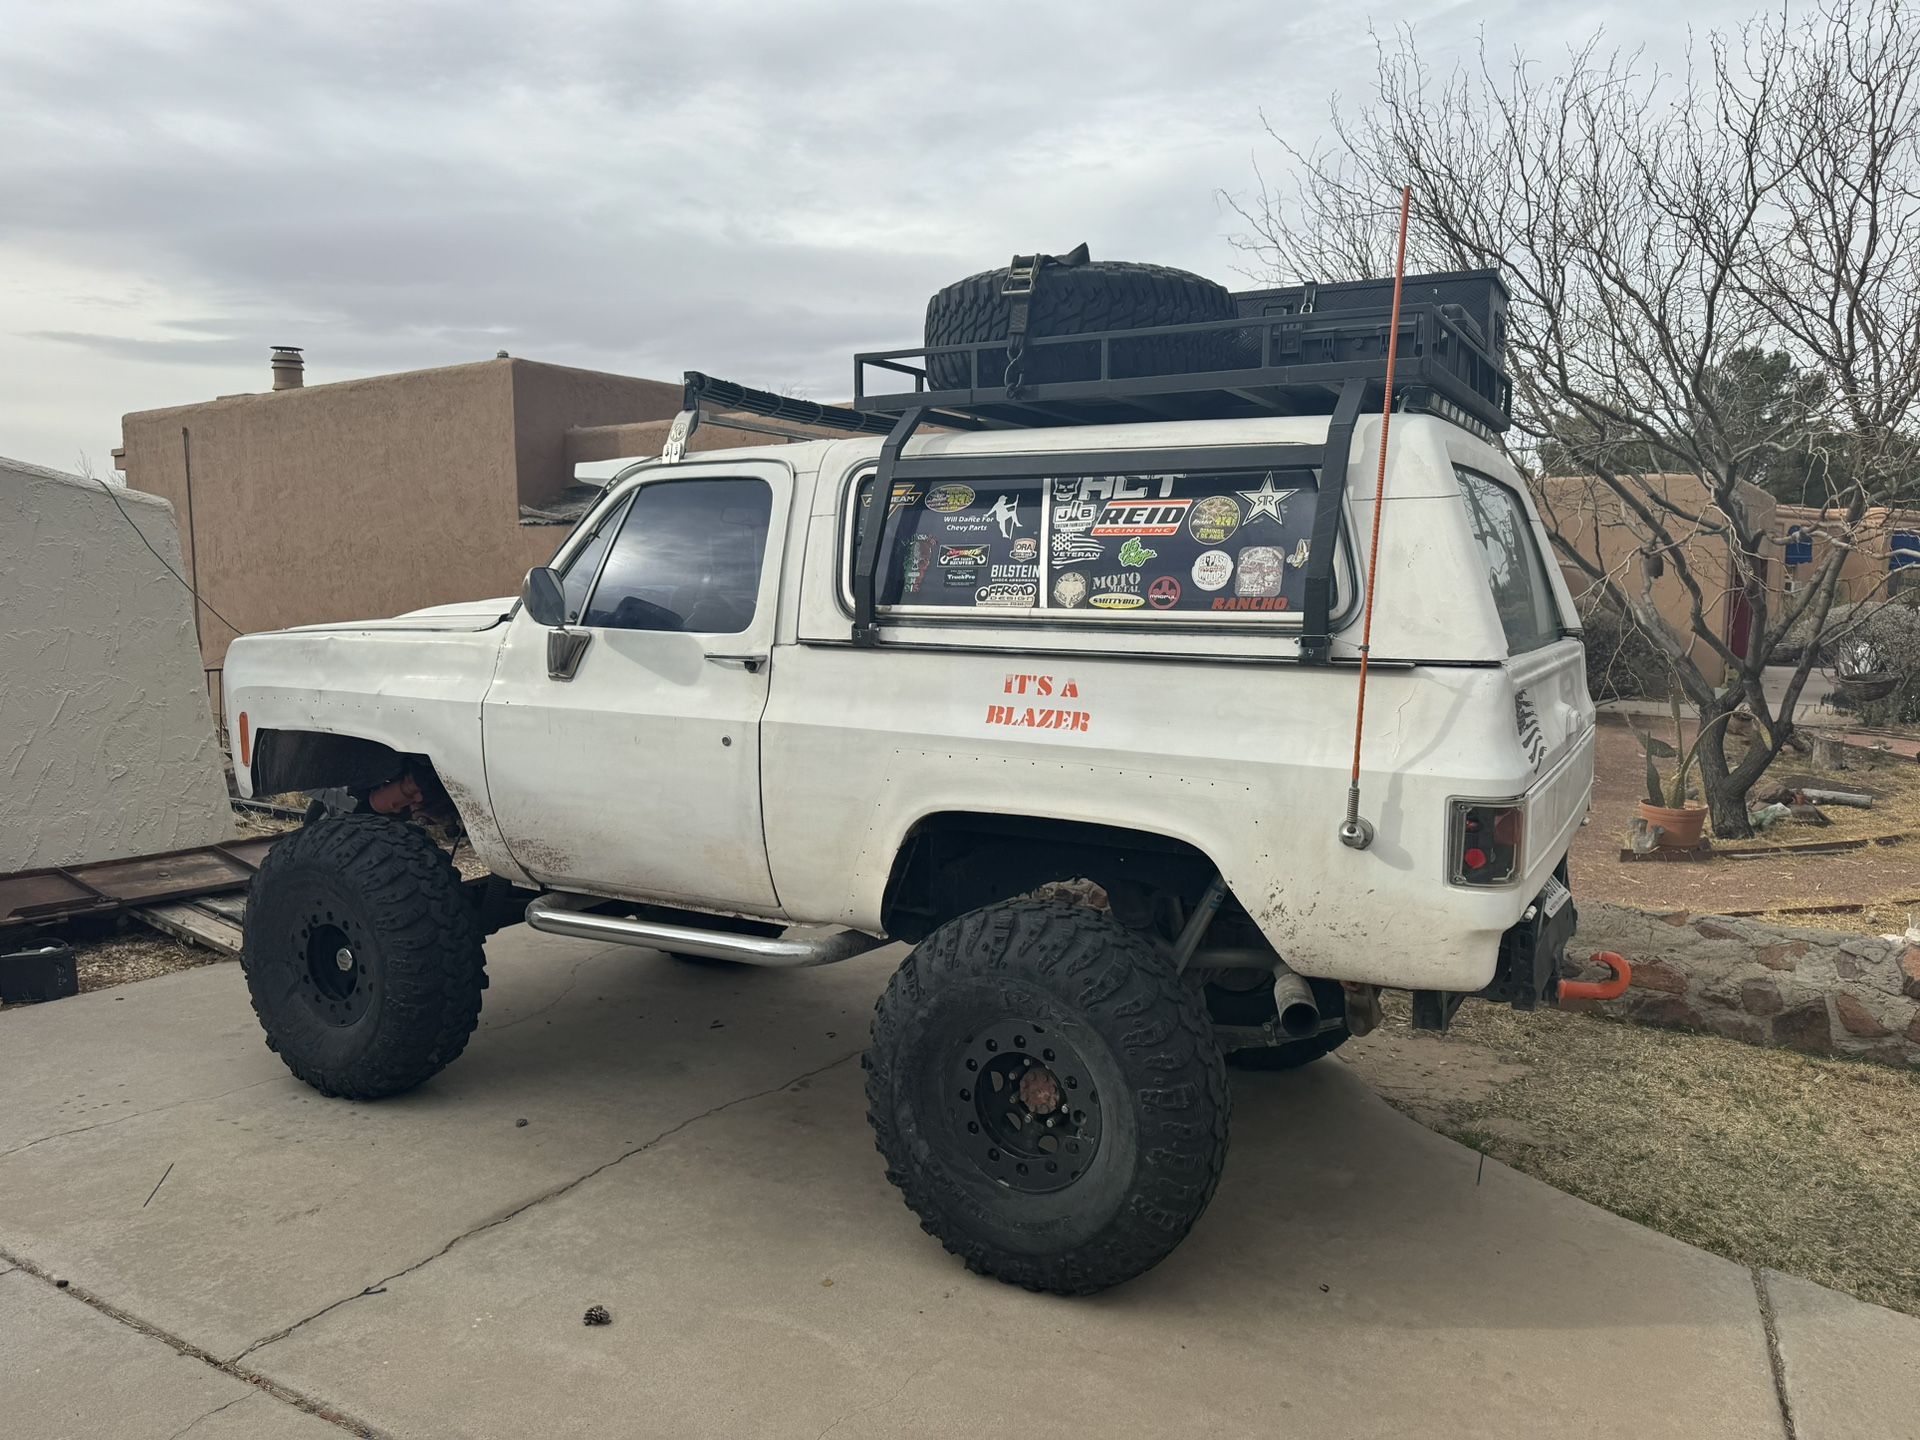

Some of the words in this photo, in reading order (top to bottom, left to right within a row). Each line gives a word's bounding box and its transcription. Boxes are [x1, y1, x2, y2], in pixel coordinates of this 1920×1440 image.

[943, 515, 958, 523] Will
[981, 515, 994, 523] For
[1097, 507, 1186, 525] REID
[1052, 550, 1100, 558] VETERAN
[990, 564, 1040, 578] BILSTEIN
[1092, 572, 1141, 589] MOTO
[1109, 585, 1141, 593] METAL
[1093, 597, 1141, 605] SMITTYBILT
[1211, 597, 1289, 610] RANCHO
[1004, 674, 1053, 697] IT'S
[1060, 678, 1079, 698] A
[985, 704, 1091, 731] BLAZER
